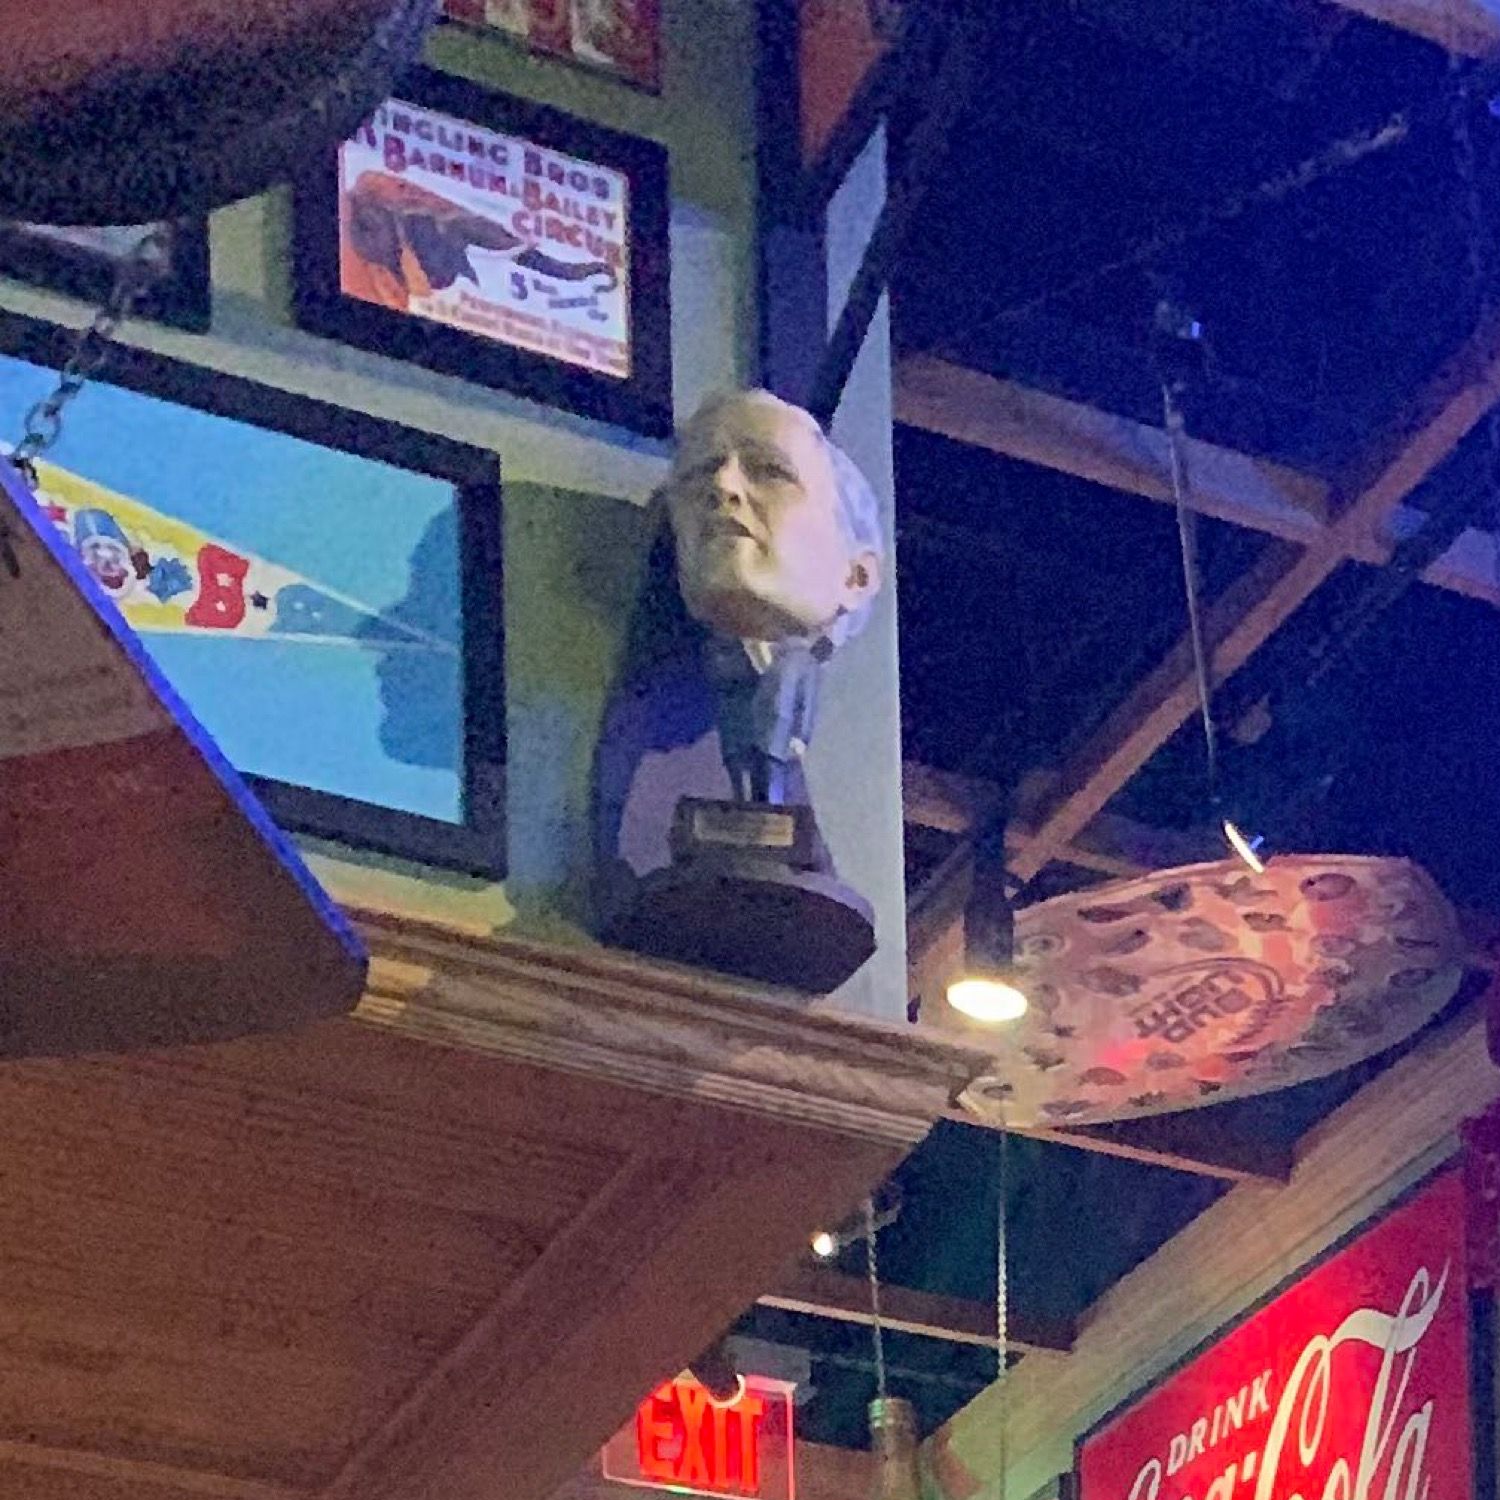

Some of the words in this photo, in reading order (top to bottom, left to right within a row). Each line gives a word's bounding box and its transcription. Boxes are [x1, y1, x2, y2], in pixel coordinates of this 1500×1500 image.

[379, 106, 510, 167] INGLING
[511, 209, 622, 268] CIRCUS
[637, 1380, 766, 1494] EXIT
[1166, 1369, 1273, 1477] DRINK
